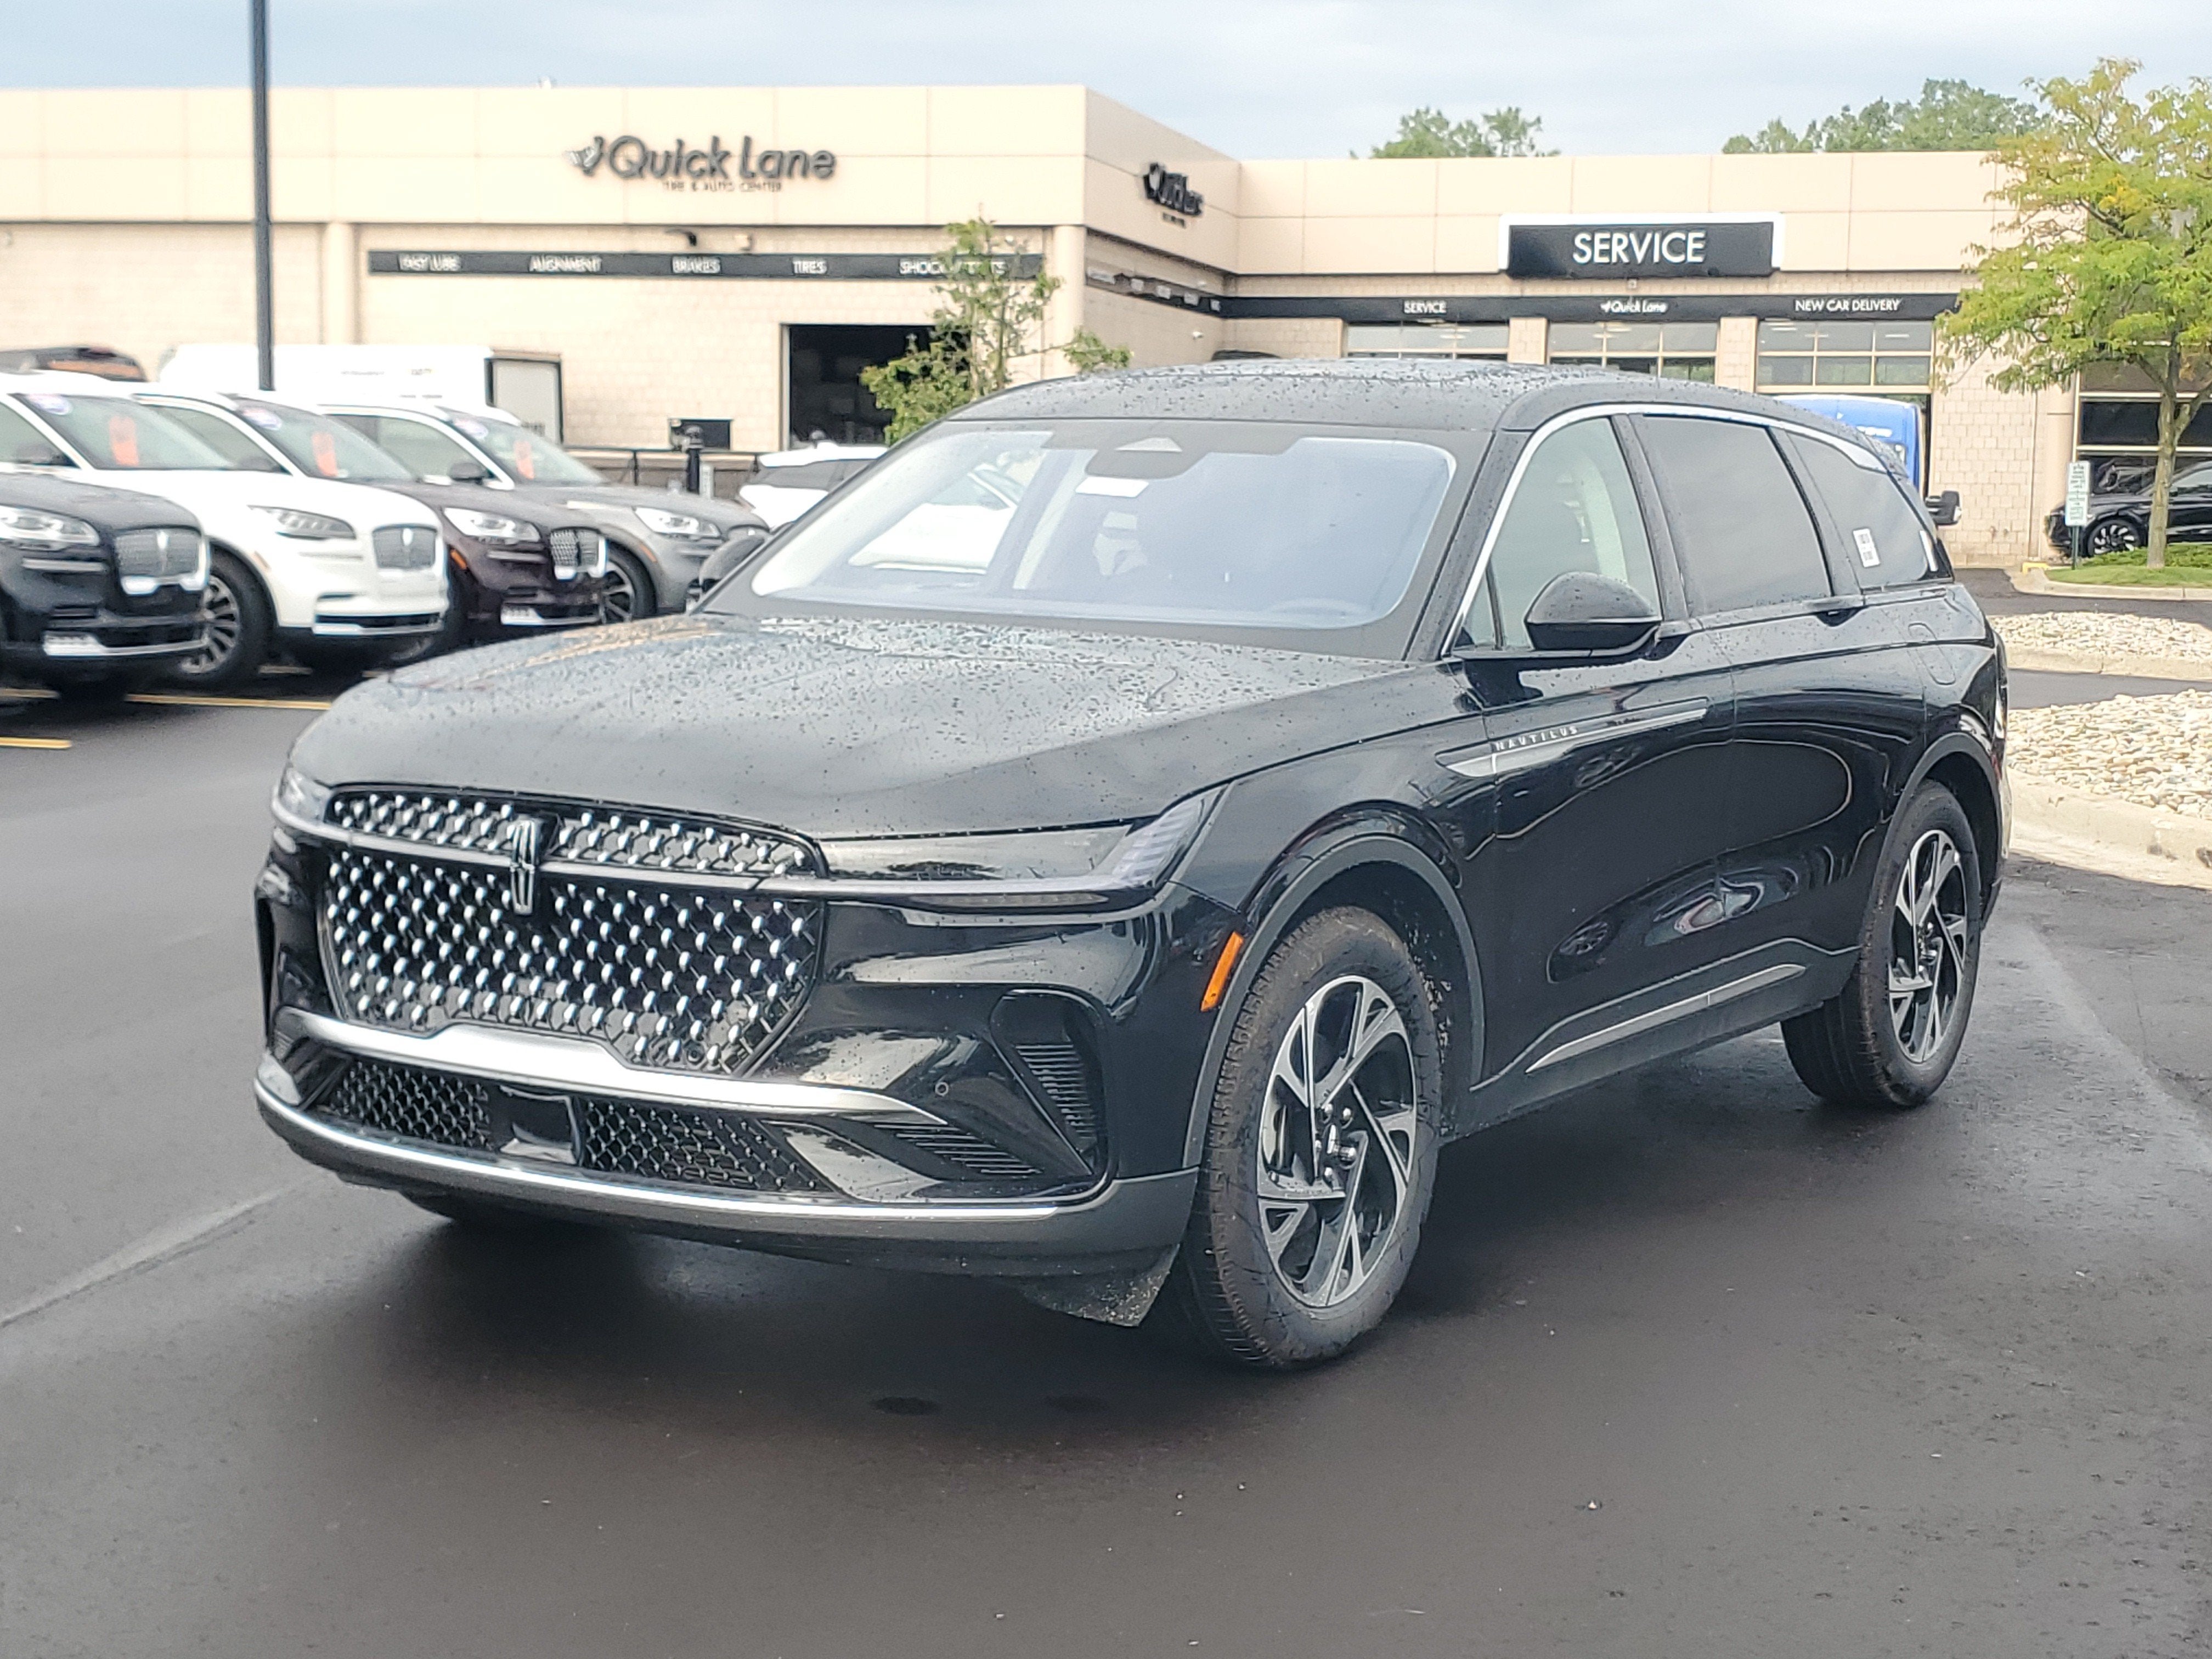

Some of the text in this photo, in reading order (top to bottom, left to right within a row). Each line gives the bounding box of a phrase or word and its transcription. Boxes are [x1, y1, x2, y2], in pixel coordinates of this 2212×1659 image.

[608, 135, 836, 179] Quick Lane
[1572, 230, 1707, 264] SERVICE
[672, 256, 720, 273] BRAKES
[792, 259, 827, 274] TIRES
[1404, 300, 1447, 314] SERVICE
[1795, 298, 1903, 312] NEW CAR DELIVERY
[1495, 725, 1578, 751] NAUTILUS
